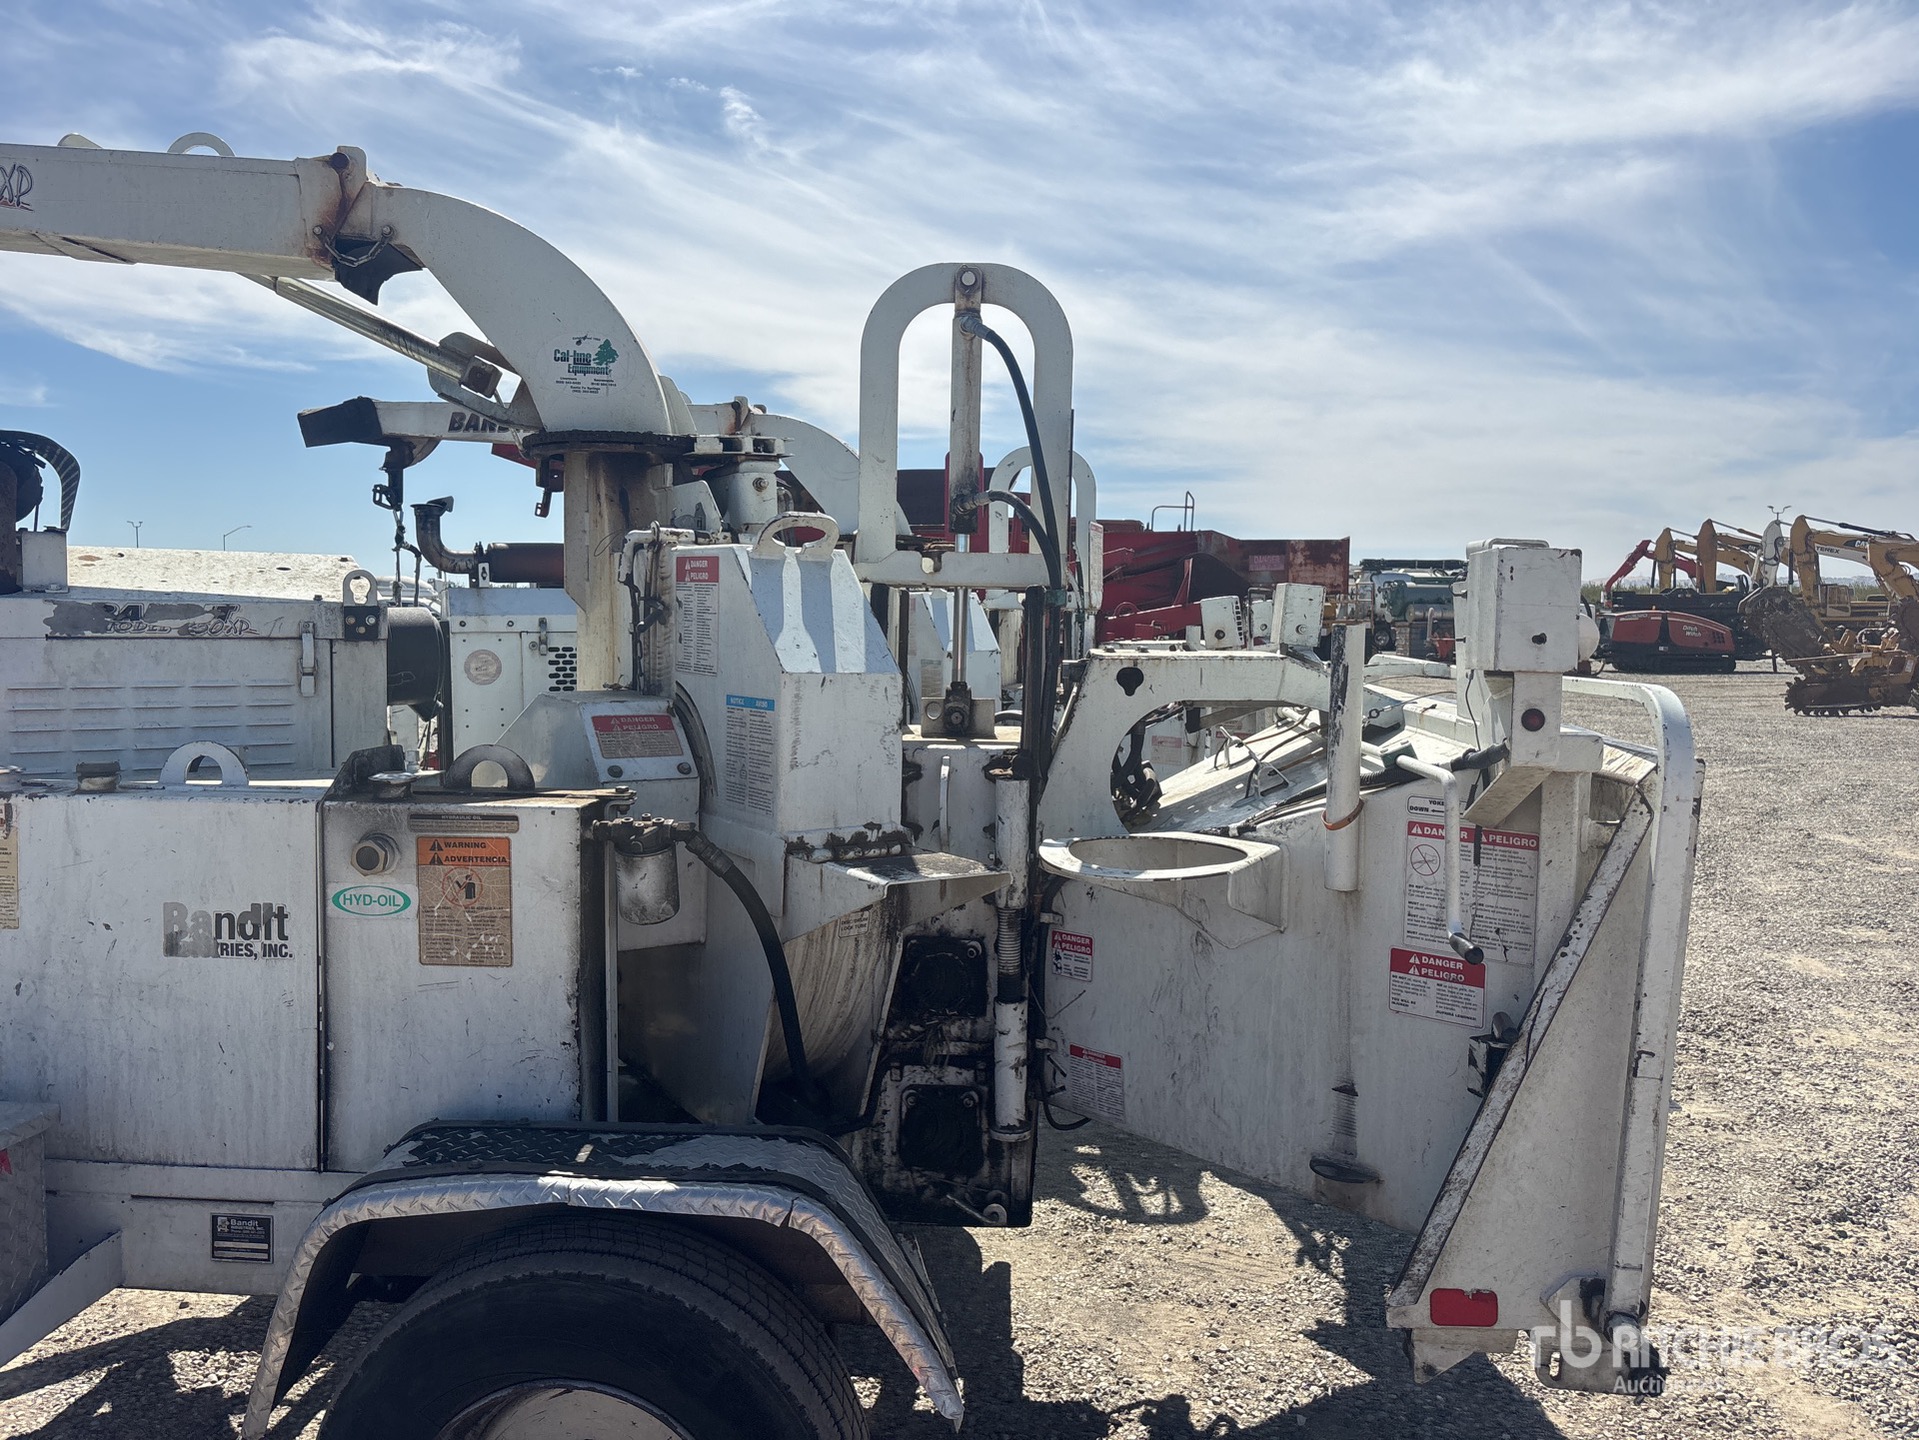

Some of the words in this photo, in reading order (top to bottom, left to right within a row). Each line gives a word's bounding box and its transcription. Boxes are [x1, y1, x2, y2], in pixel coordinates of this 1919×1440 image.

[568, 364, 609, 376] Equipment
[1816, 545, 1840, 554] TEREX
[444, 841, 487, 849] WARNING
[1488, 834, 1538, 848] PELIGRO
[444, 855, 508, 863] ADVERTENCIA
[342, 893, 401, 907] HYD-OIL
[1061, 934, 1090, 944] DANGER
[262, 943, 293, 958] INC.
[1061, 943, 1091, 954] PELIGRO
[1421, 956, 1464, 970] DANGER
[1421, 967, 1465, 982] PELIGRO
[230, 1219, 259, 1227] Bandit
